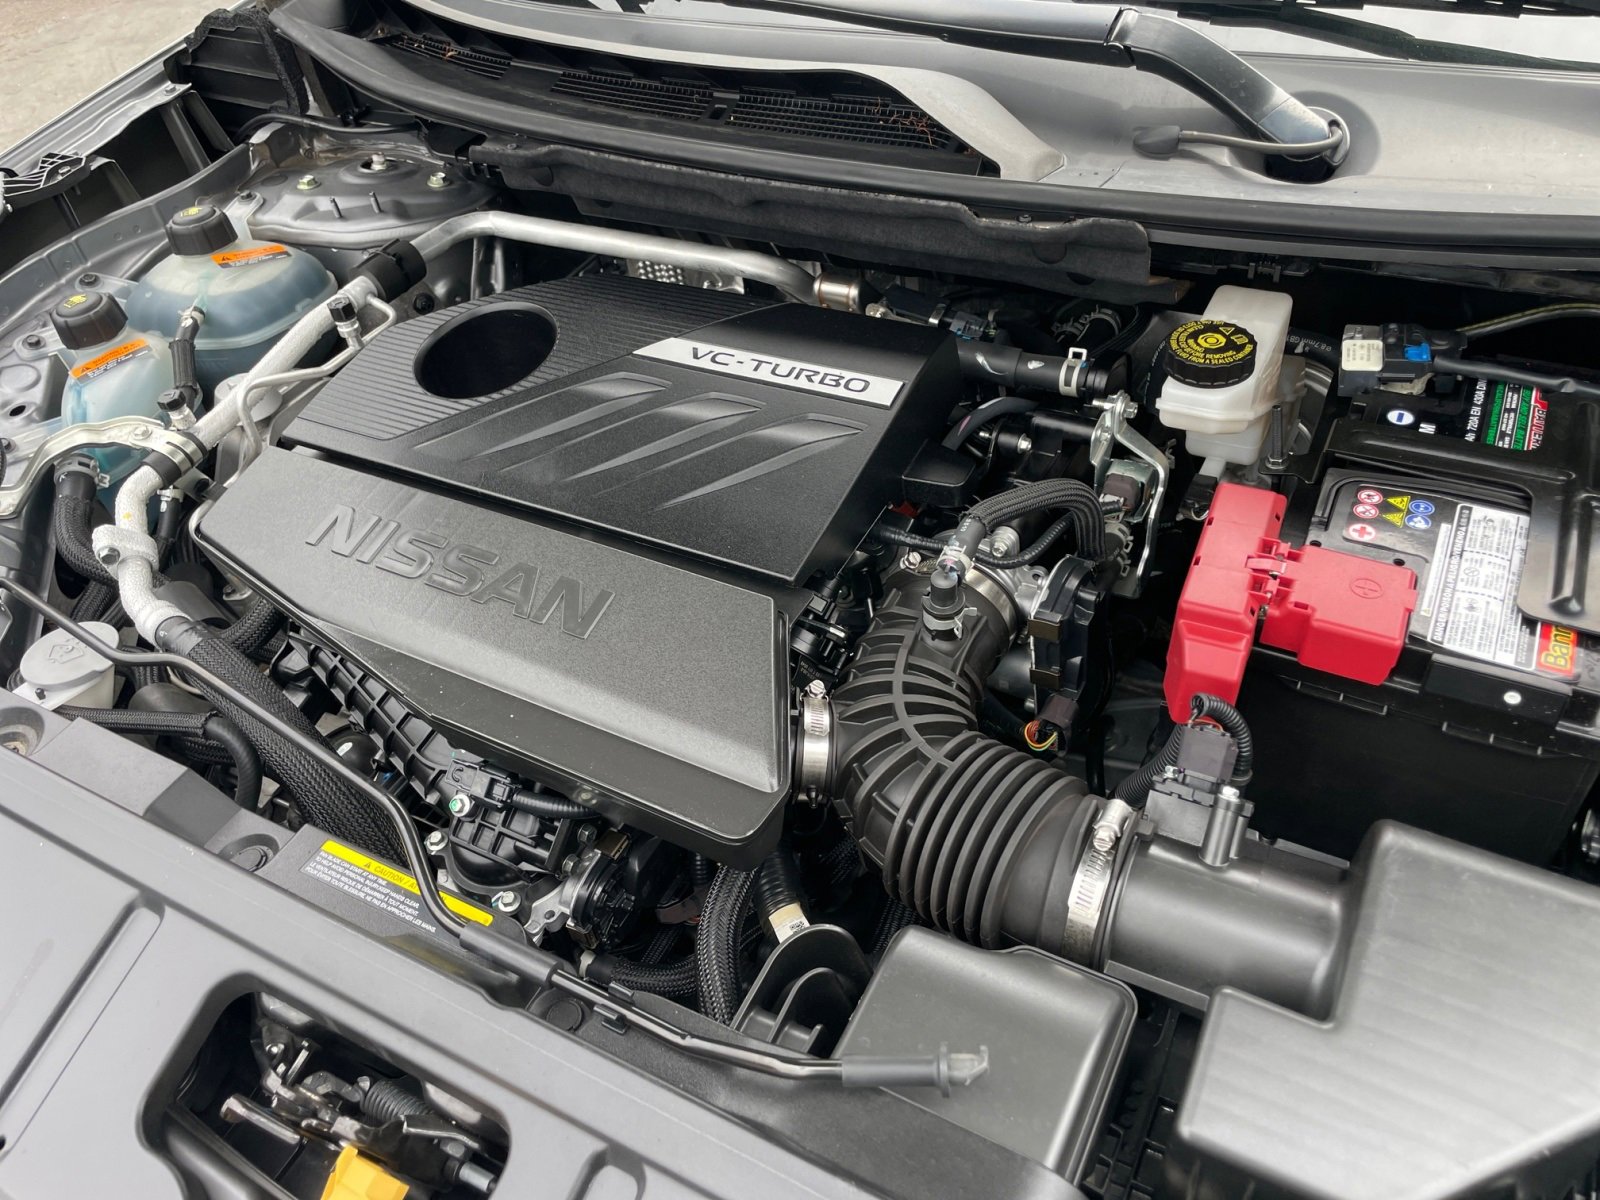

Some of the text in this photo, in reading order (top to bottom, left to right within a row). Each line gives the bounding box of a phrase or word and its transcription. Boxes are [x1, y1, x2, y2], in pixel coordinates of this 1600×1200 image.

[1188, 355, 1205, 363] FROM
[1473, 391, 1486, 405] 430A
[1470, 406, 1482, 416] EN
[1467, 416, 1480, 431] 720A
[305, 504, 616, 640] NISSAN
[374, 865, 403, 883] CAUTION
